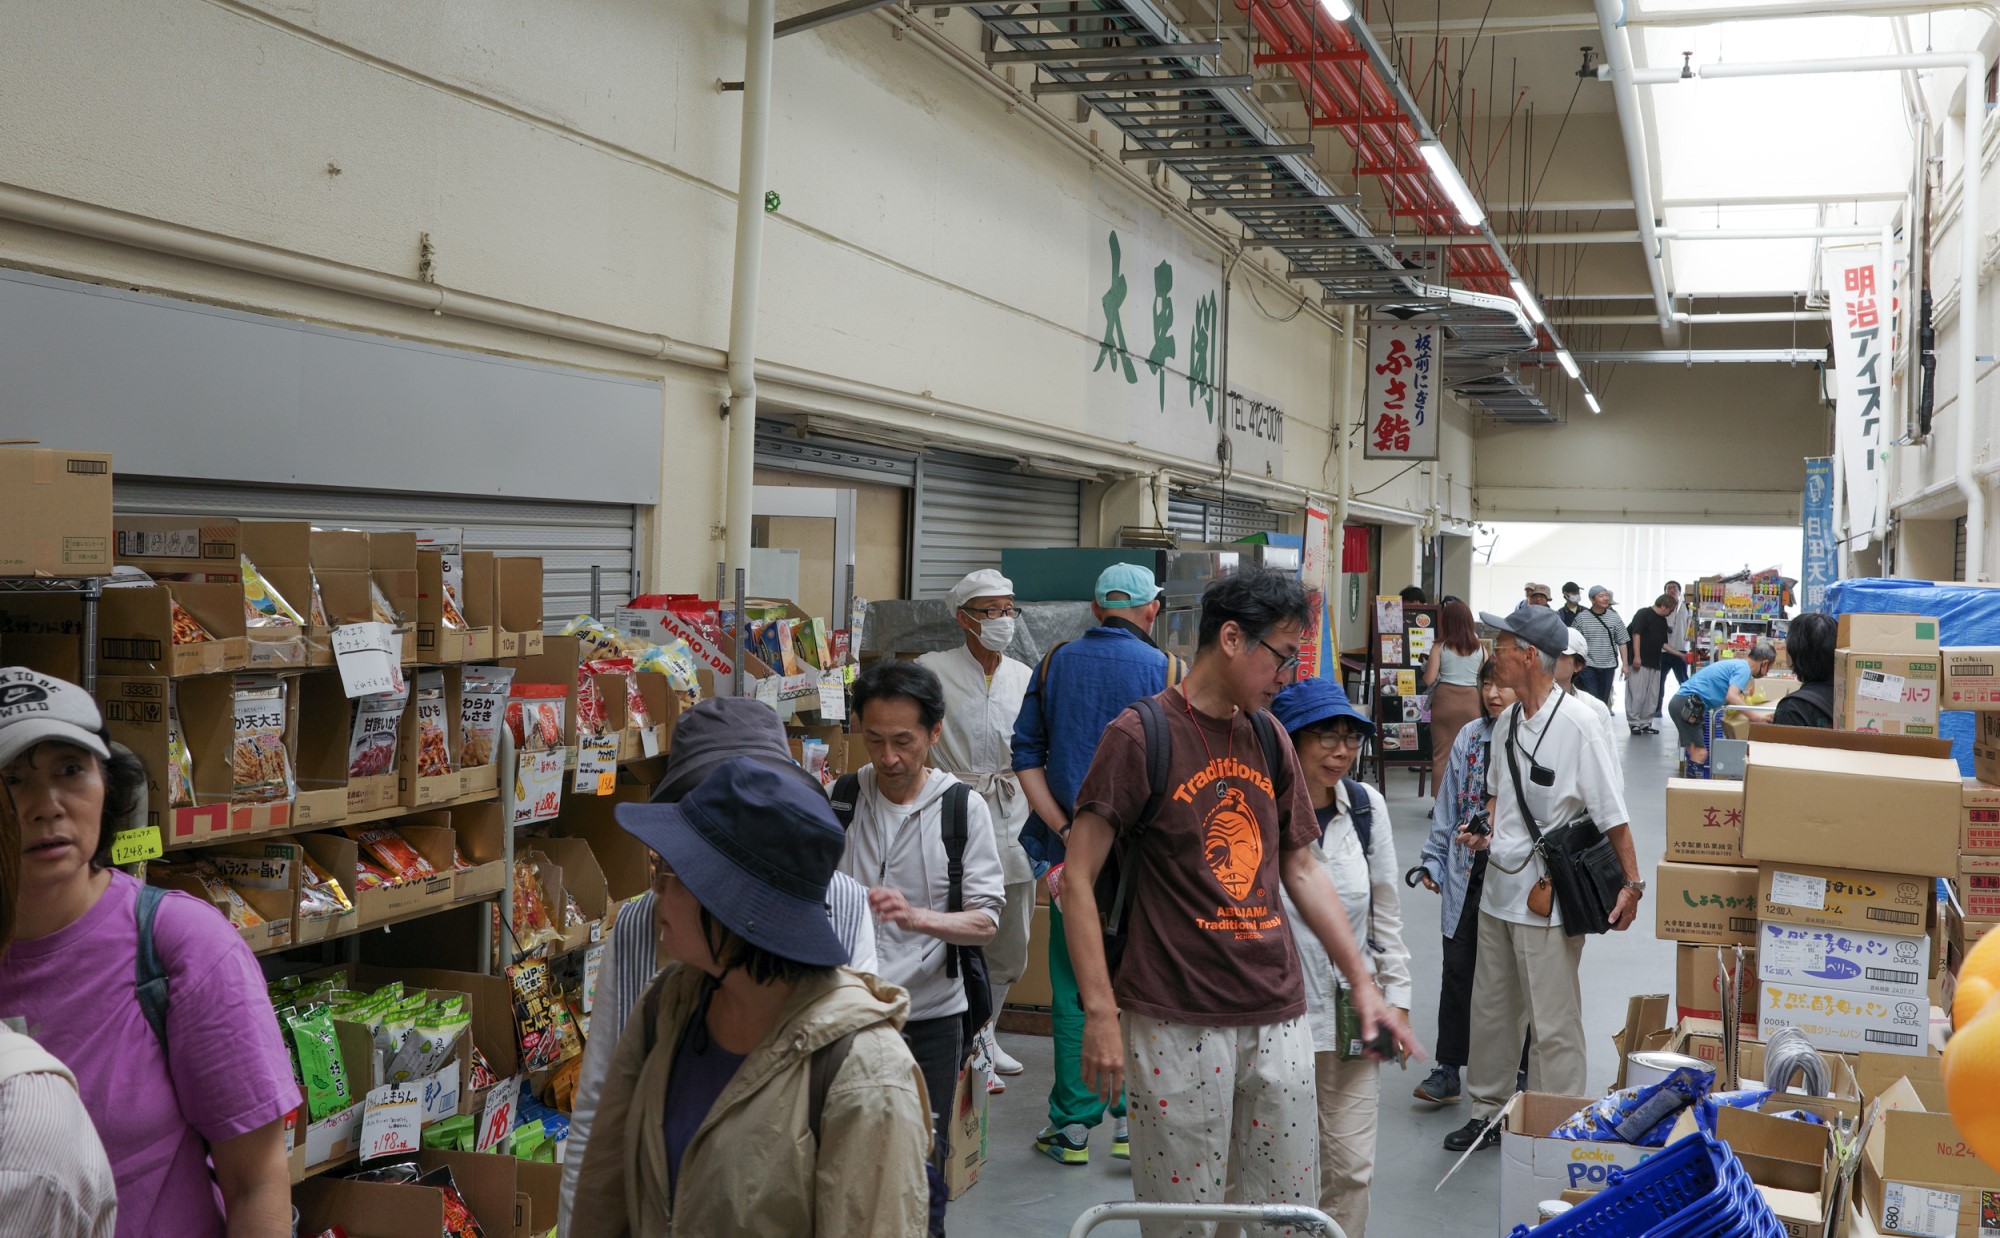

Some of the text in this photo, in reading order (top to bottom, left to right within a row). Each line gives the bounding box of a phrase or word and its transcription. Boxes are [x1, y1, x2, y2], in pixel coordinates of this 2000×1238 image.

[1413, 333, 1432, 427] 板前にぎり
[1372, 339, 1412, 452] ふさ鮨
[1228, 390, 1246, 431] TEL
[1807, 516, 1827, 612] 日田天領
[659, 615, 703, 654] NACHO
[709, 656, 732, 677] DIP
[1910, 663, 1936, 671] 57553
[14, 671, 34, 682] TO
[38, 678, 62, 693] BE
[124, 684, 159, 695] 33321
[1900, 687, 1931, 703] ーハーフ
[0, 702, 50, 718] WILD
[1703, 806, 1742, 828] 玄米
[1765, 905, 1793, 916] 12個入
[1767, 987, 1888, 1018] 天然酵母パン
[1764, 1018, 1790, 1027] 00051
[1571, 1147, 1615, 1162] Cookie
[1885, 1206, 1900, 1230] 680
